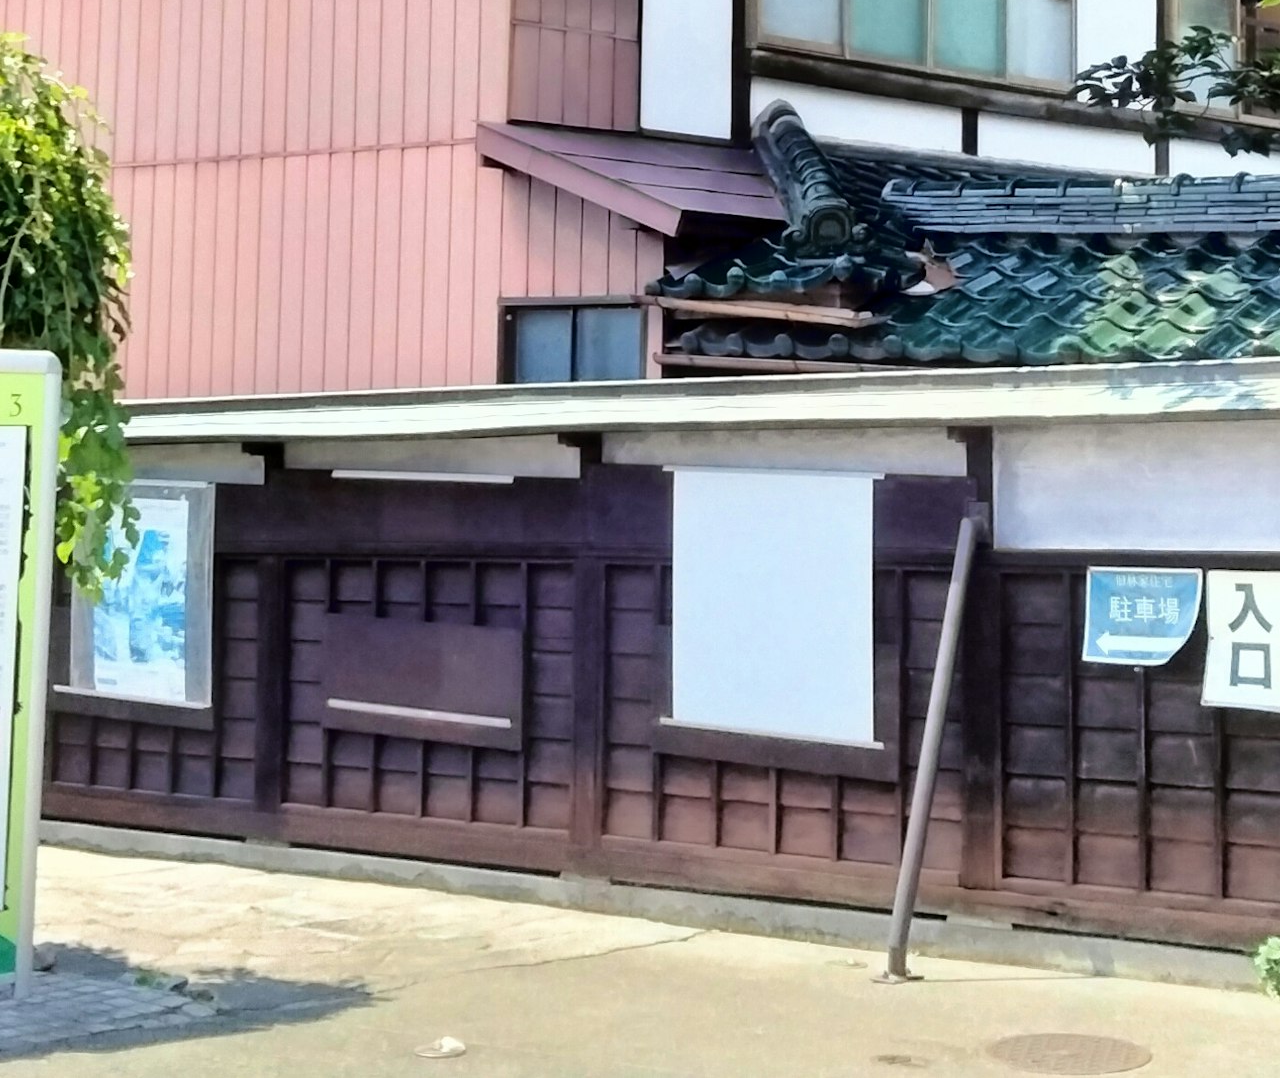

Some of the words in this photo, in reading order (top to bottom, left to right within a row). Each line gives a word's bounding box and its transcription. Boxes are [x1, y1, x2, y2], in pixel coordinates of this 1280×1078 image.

[9, 393, 22, 417] 3
[1109, 596, 1180, 624] 駐車場
[1228, 583, 1272, 689] 入口
